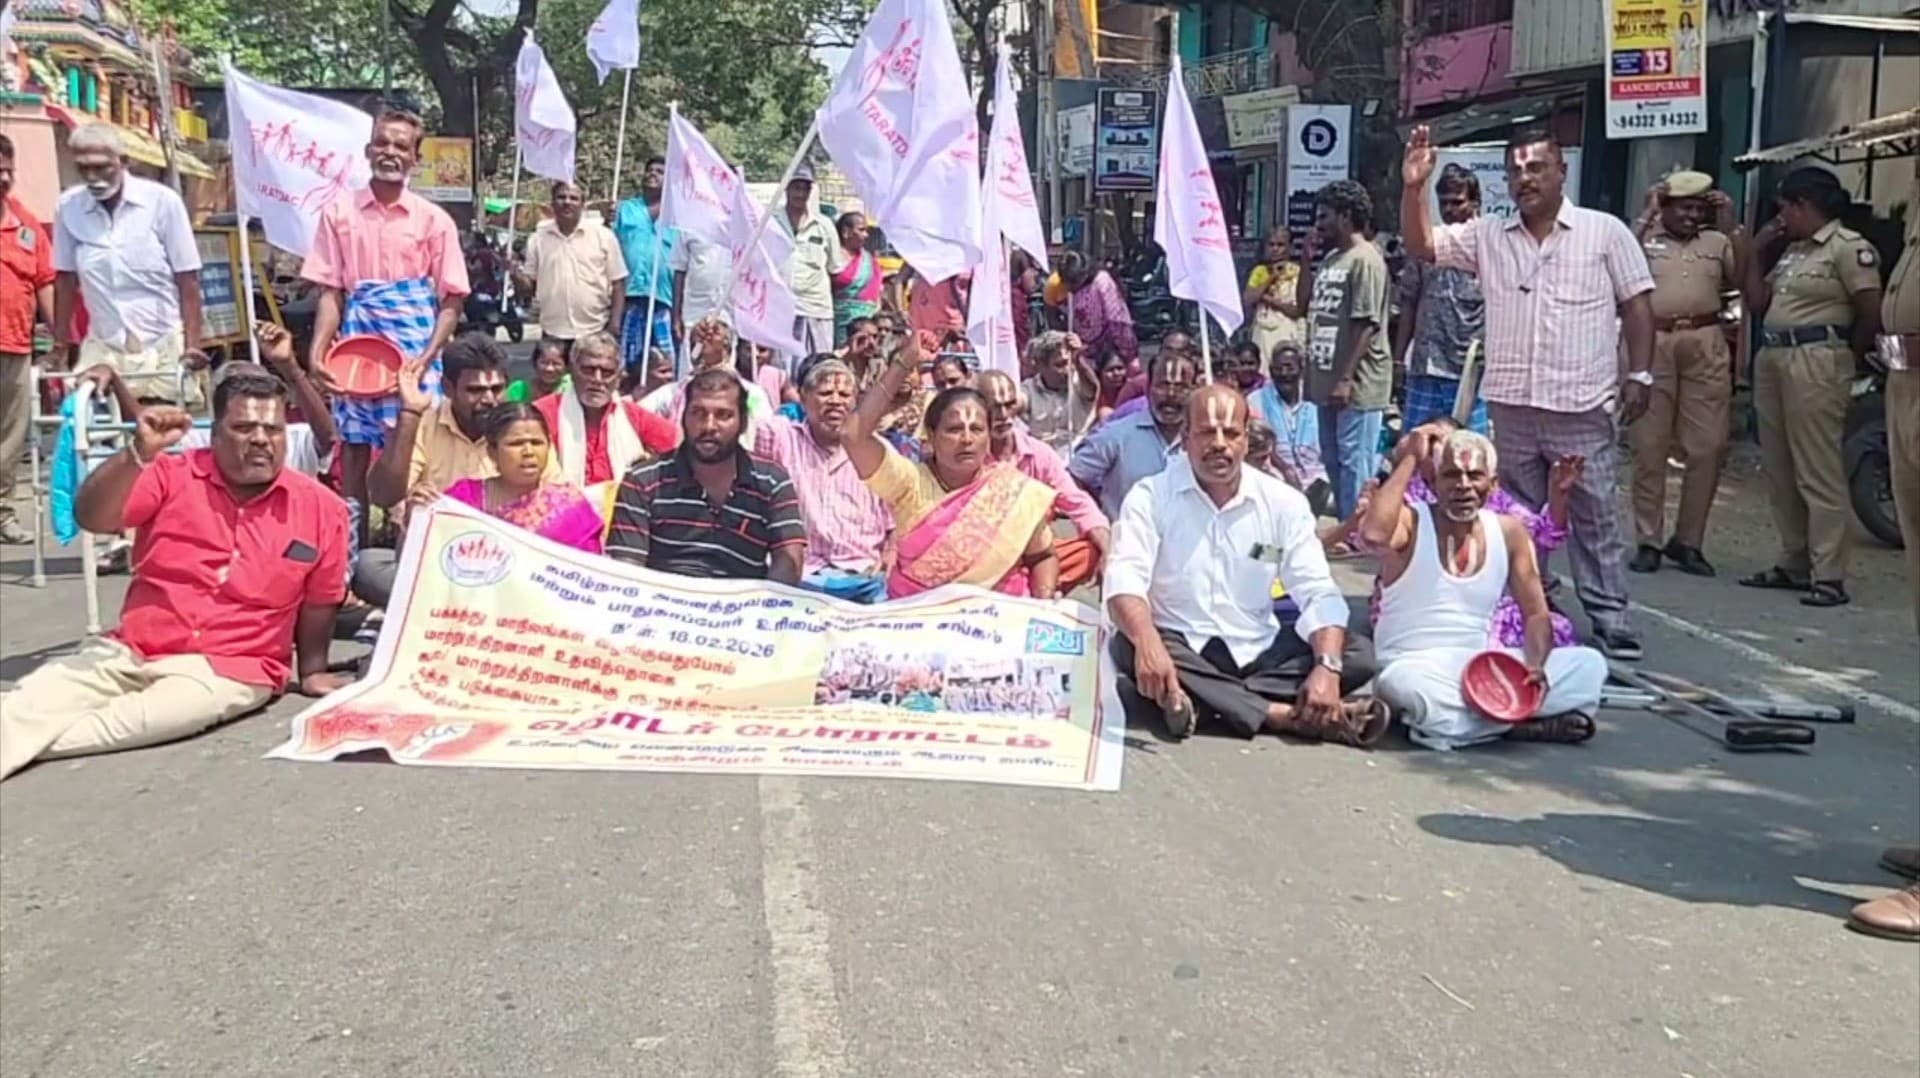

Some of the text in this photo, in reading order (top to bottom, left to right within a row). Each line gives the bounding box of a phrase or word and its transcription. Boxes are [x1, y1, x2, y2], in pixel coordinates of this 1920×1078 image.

[1646, 50, 1668, 71] 13
[1620, 112, 1698, 128] 94332 94332
[669, 630, 775, 659] 18.02.2026
[735, 724, 1052, 749] போராட்டம்
